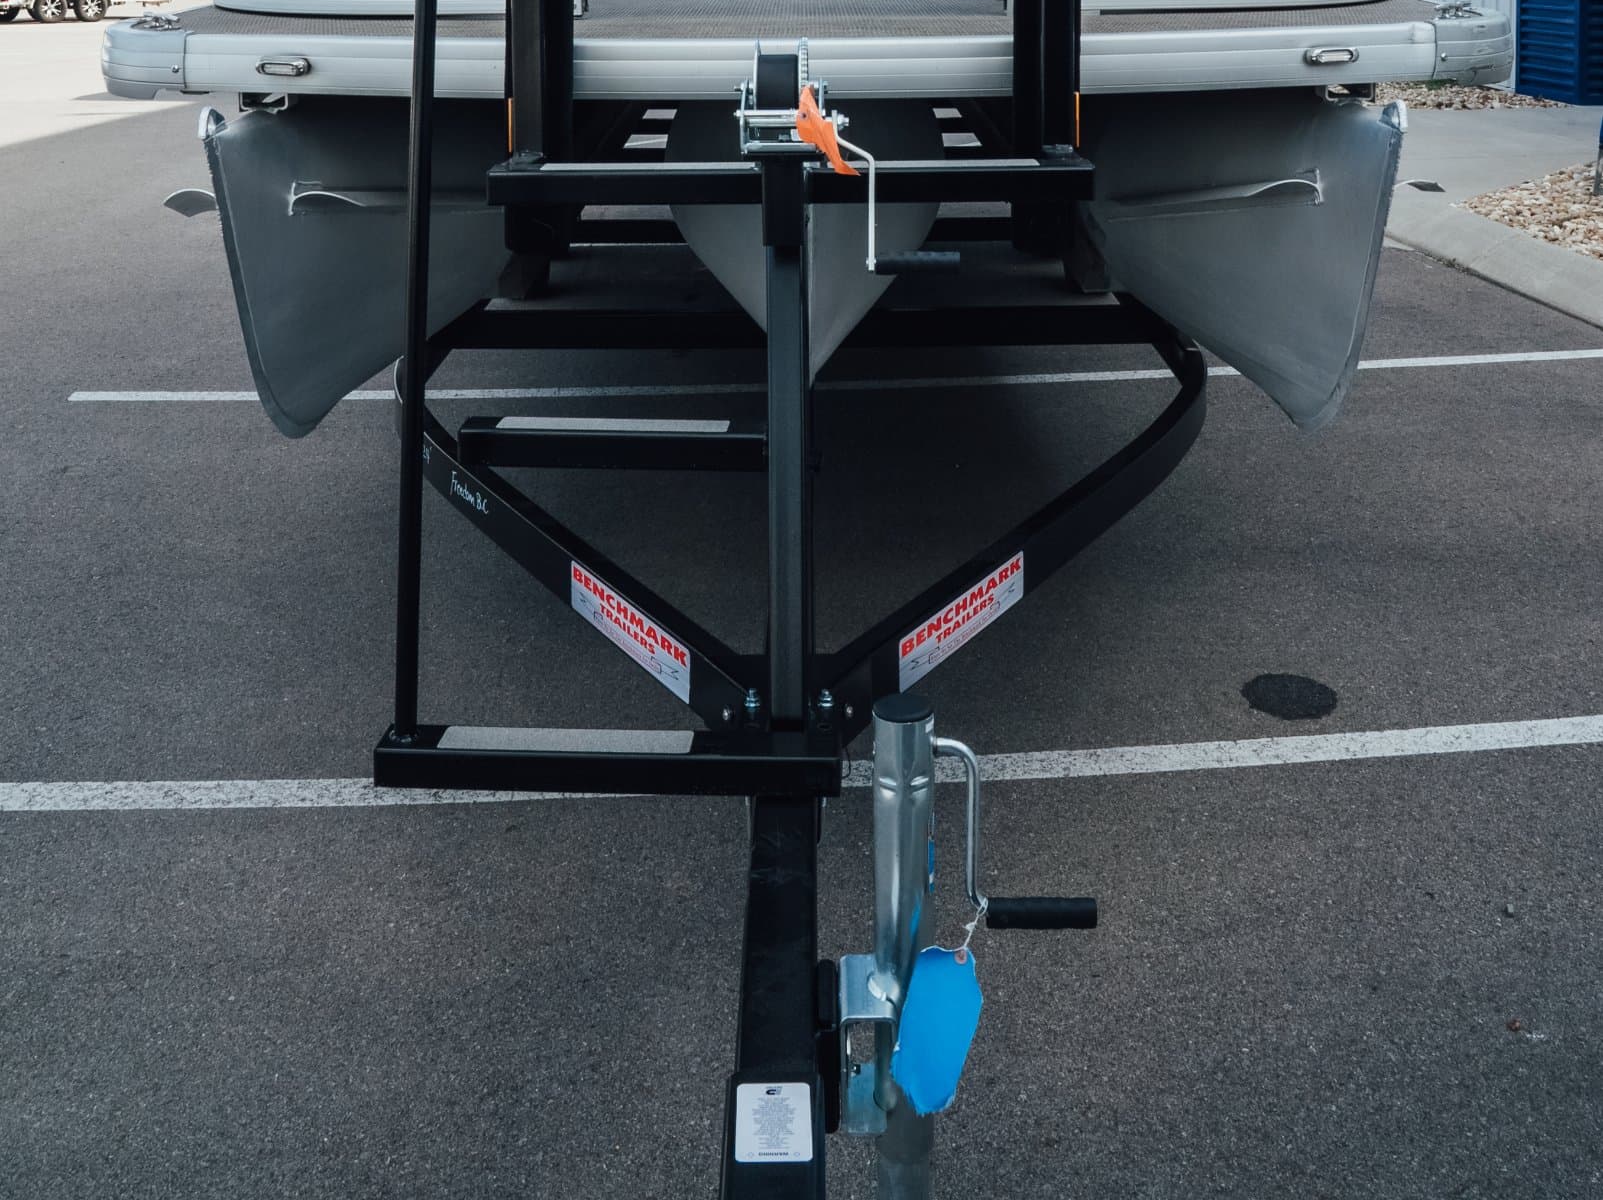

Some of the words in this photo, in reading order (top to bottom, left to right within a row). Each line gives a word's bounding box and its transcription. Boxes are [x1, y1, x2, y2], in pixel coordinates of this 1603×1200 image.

[573, 565, 688, 668] BENCHMARK
[600, 603, 656, 655] TRAILERS
[902, 556, 1021, 657] BENCHMARK
[936, 593, 995, 644] TRAILERS
